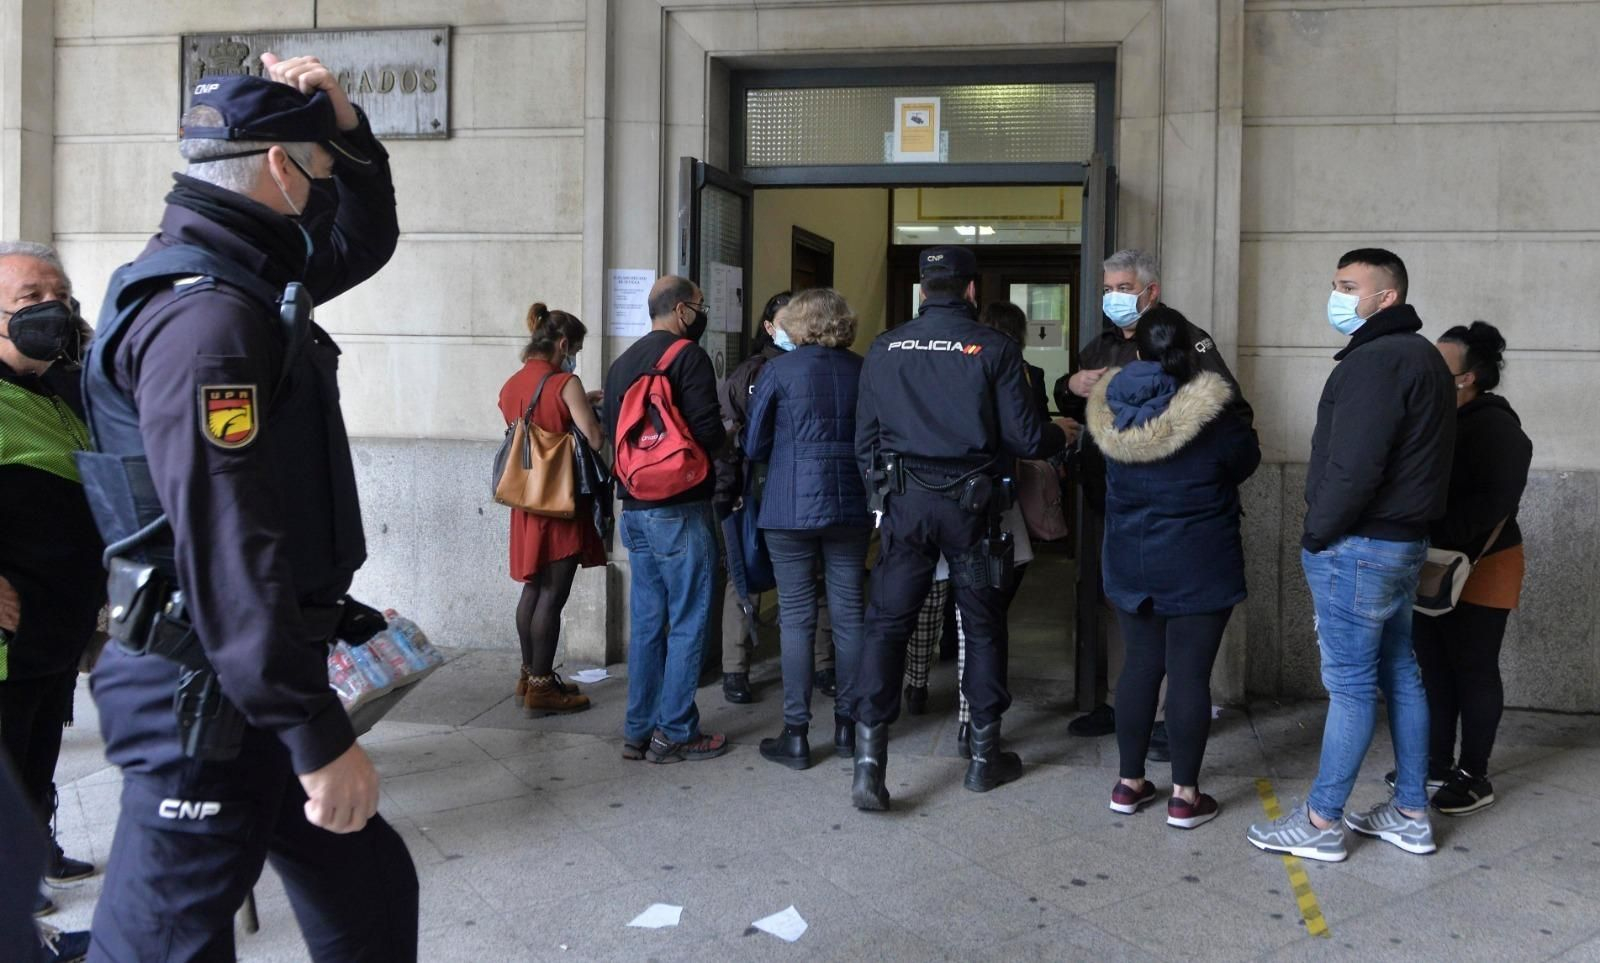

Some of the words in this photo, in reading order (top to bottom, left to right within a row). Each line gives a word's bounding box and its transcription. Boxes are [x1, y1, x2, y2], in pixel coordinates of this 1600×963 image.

[337, 69, 438, 94] GADOS
[194, 83, 220, 95] CNP
[927, 254, 944, 262] CNP
[887, 339, 964, 352] POLICIA
[159, 798, 222, 820] CNP
